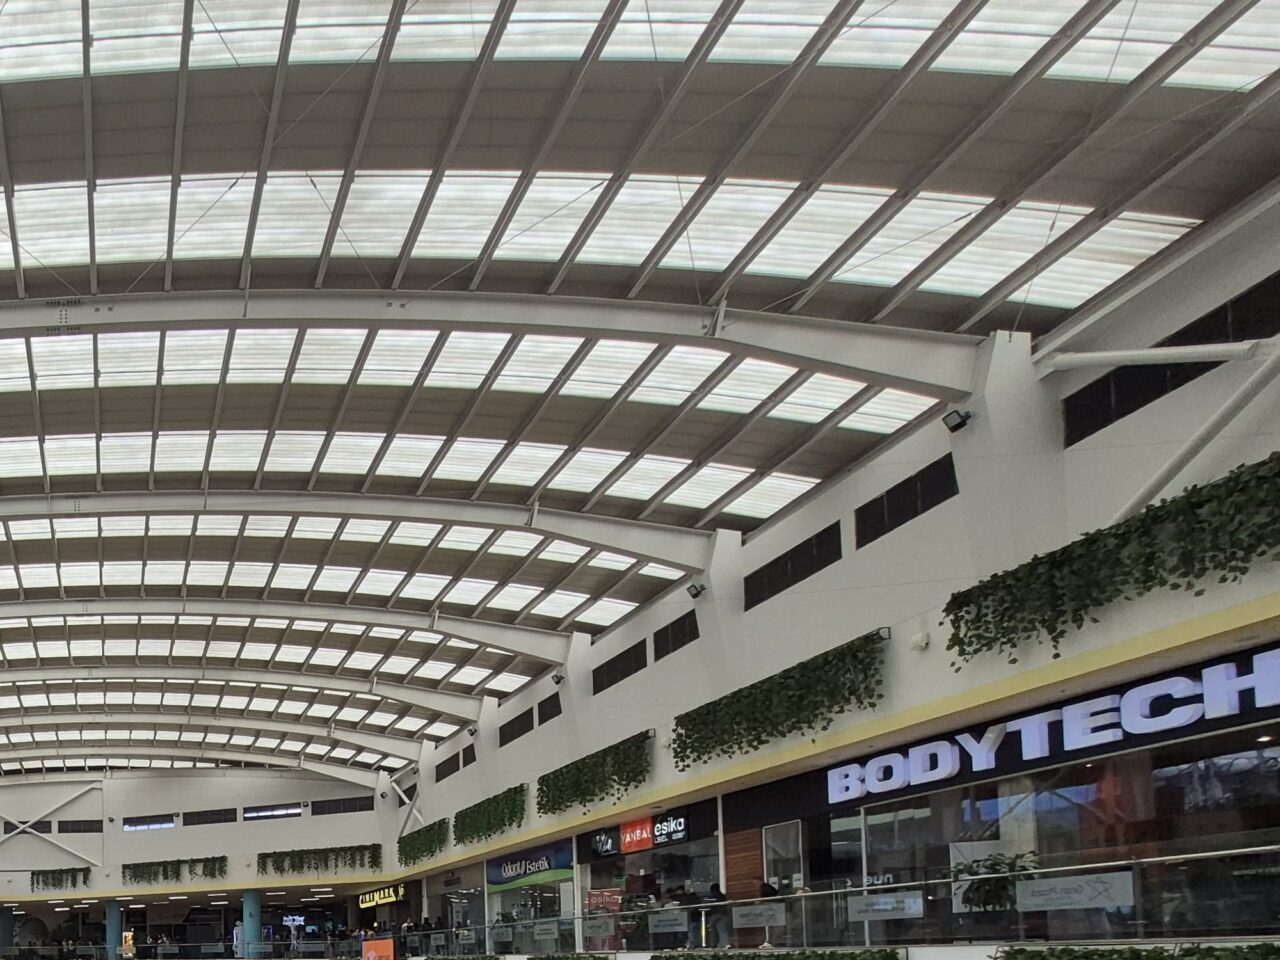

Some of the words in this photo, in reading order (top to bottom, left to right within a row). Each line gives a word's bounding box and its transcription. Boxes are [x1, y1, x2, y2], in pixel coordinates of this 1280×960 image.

[827, 647, 1280, 805] BODYTECH
[620, 828, 653, 844] YANBAL
[526, 856, 550, 873] Estetik
[359, 887, 397, 909] CINEMARK
